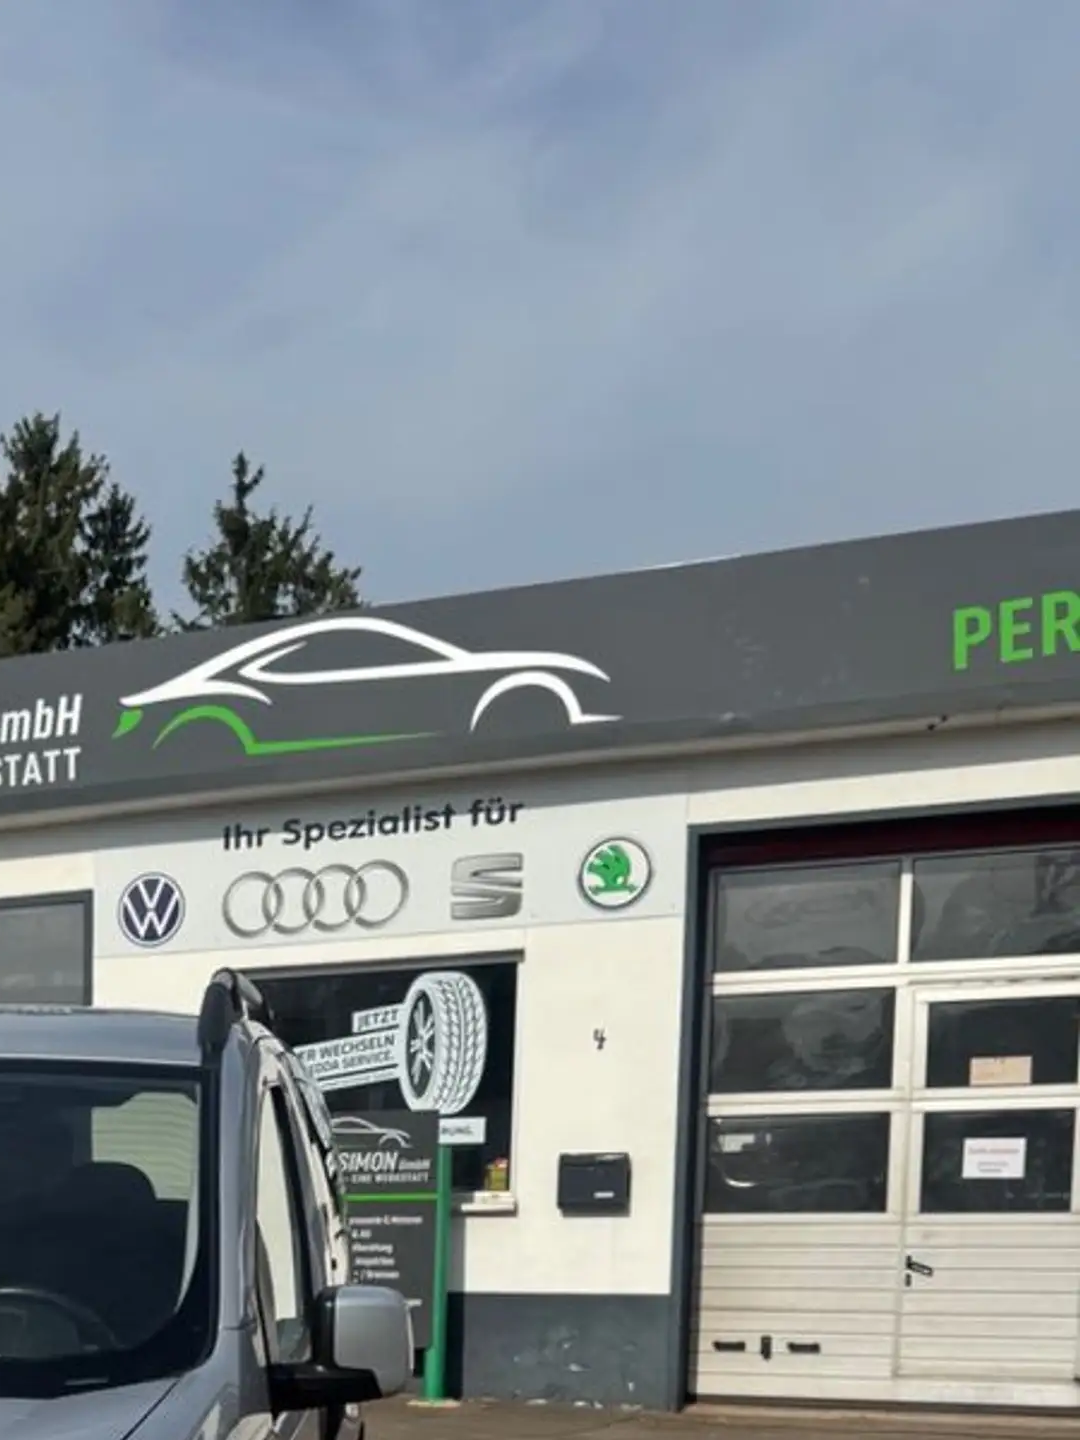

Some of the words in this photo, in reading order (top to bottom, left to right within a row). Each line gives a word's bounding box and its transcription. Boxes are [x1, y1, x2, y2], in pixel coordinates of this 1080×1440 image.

[953, 590, 1080, 670] PER
[223, 823, 271, 850] Ihr
[282, 803, 457, 850] Spezialist
[468, 797, 525, 827] für
[357, 1008, 399, 1031] JETZT
[319, 1034, 395, 1059] WECHSELN
[593, 1027, 607, 1051] 4
[338, 1151, 399, 1172] SIMON
